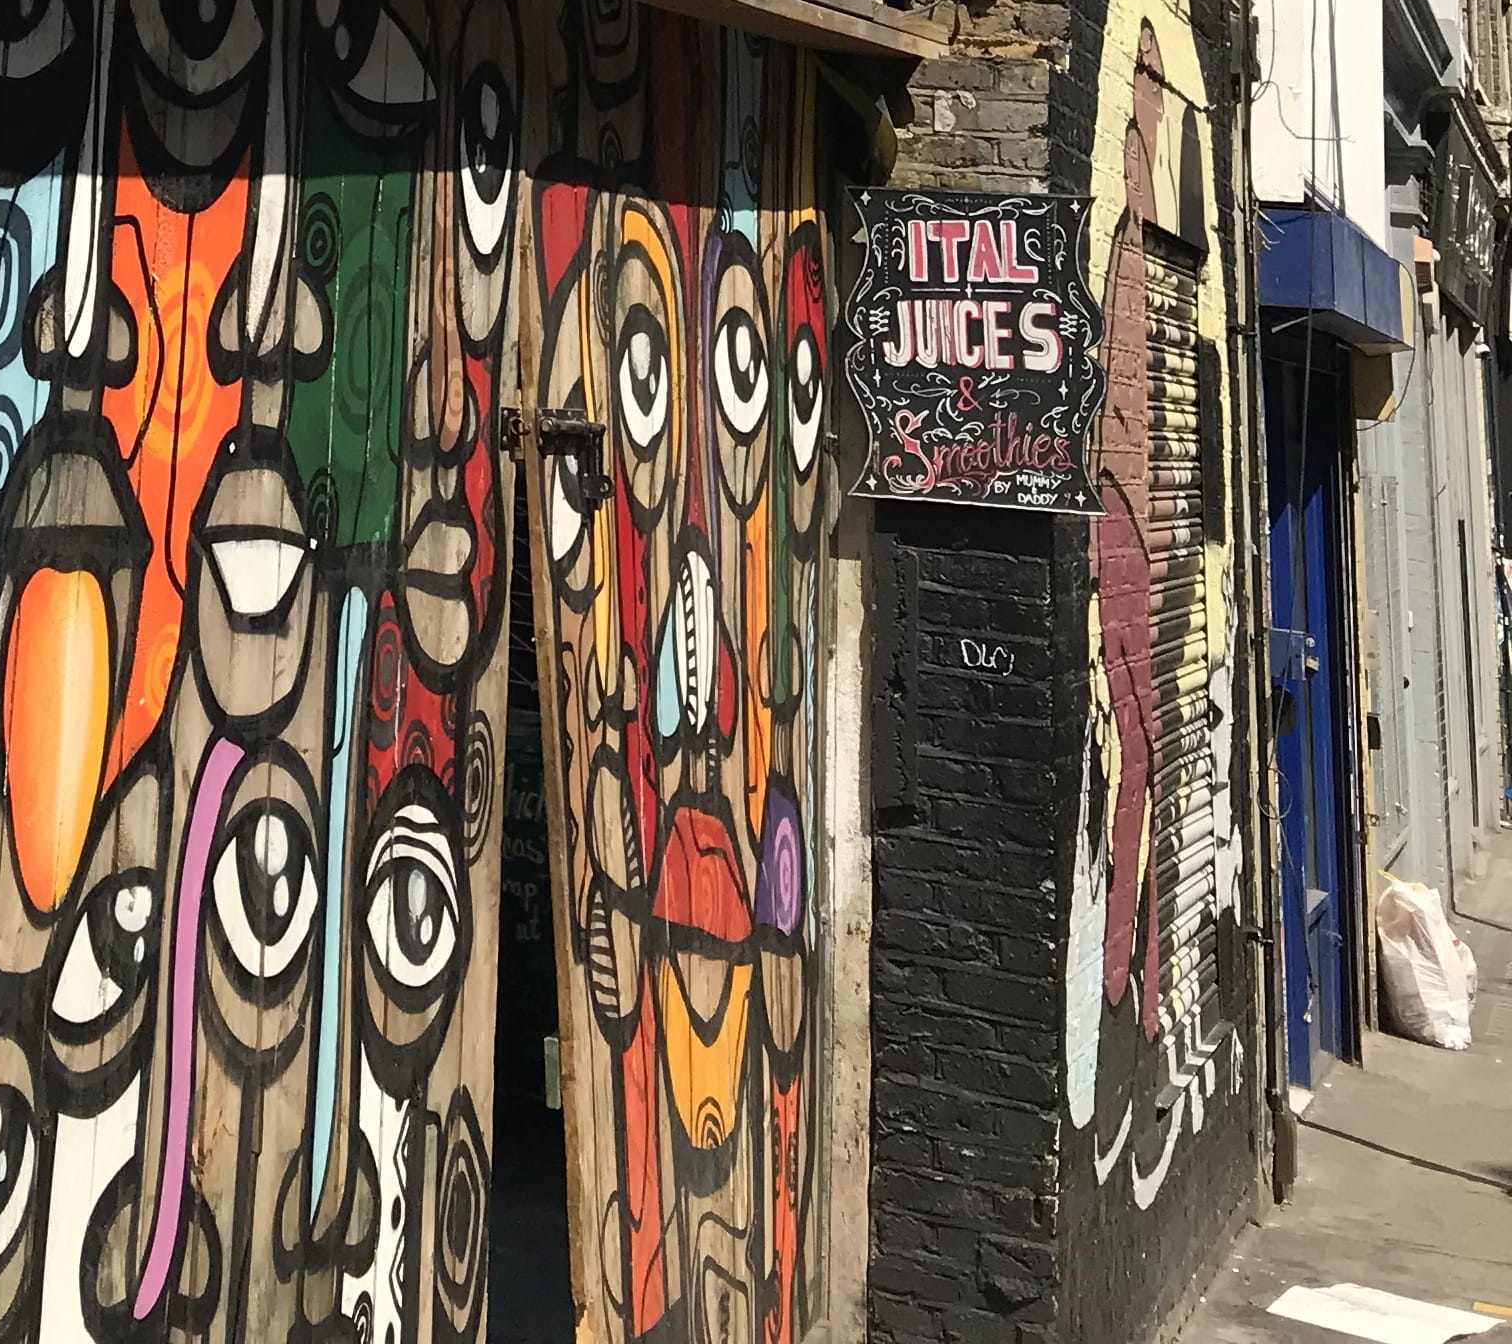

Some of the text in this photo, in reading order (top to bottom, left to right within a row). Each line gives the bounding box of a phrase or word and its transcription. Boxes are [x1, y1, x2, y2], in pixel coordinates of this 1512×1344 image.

[906, 219, 1039, 284] ITAL
[882, 299, 1064, 374] JUICES
[957, 375, 983, 411] &
[883, 410, 1078, 494] Smoothies
[994, 474, 1062, 494] BY MUMMY
[1018, 492, 1059, 505] DADDY
